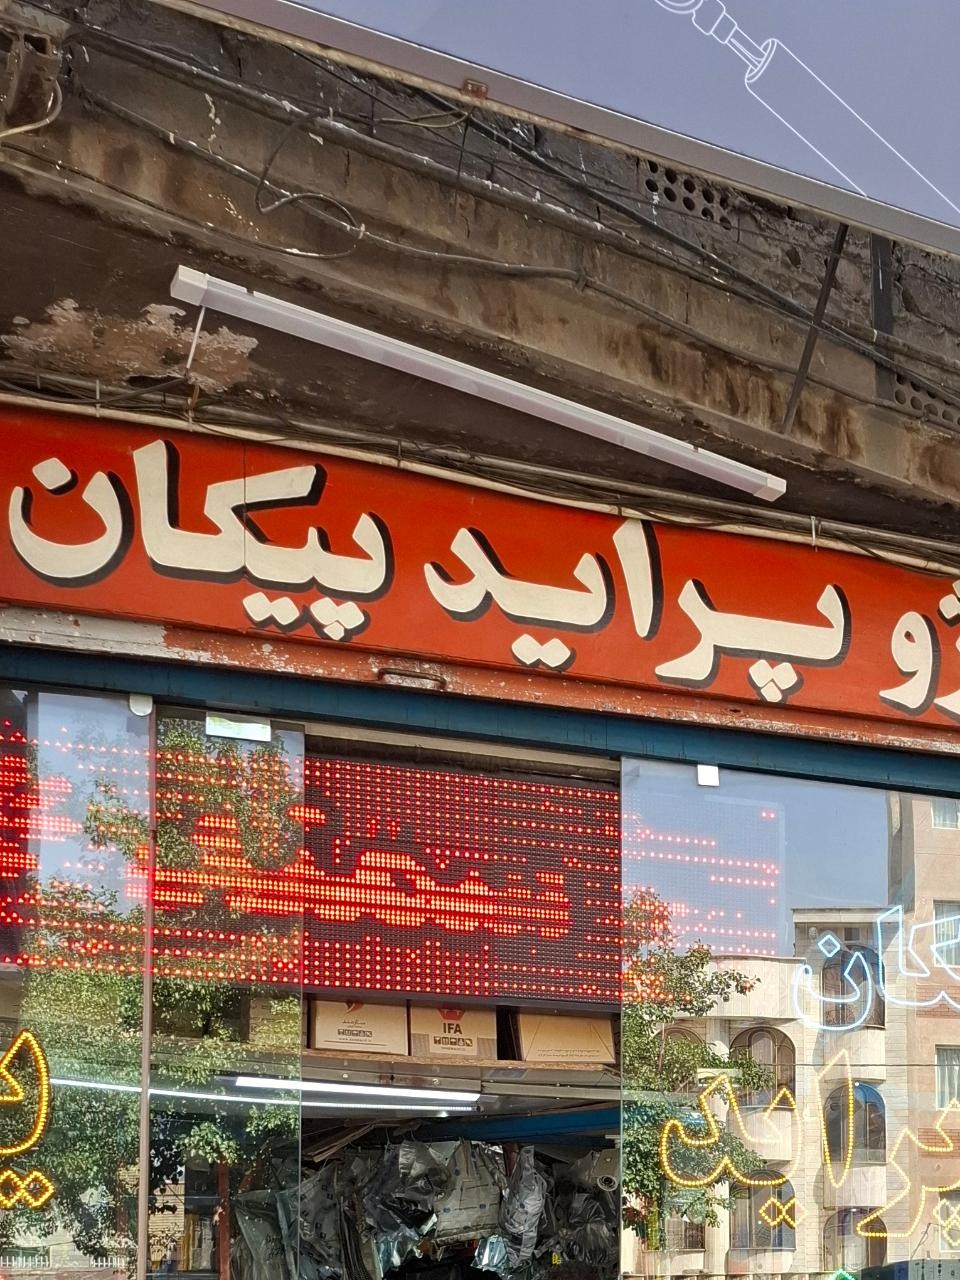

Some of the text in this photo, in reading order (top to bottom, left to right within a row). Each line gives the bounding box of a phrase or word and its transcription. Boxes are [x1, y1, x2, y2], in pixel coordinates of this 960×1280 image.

[8, 439, 391, 641] پیکان
[423, 518, 847, 703] پراید
[442, 1022, 463, 1035] IFA
